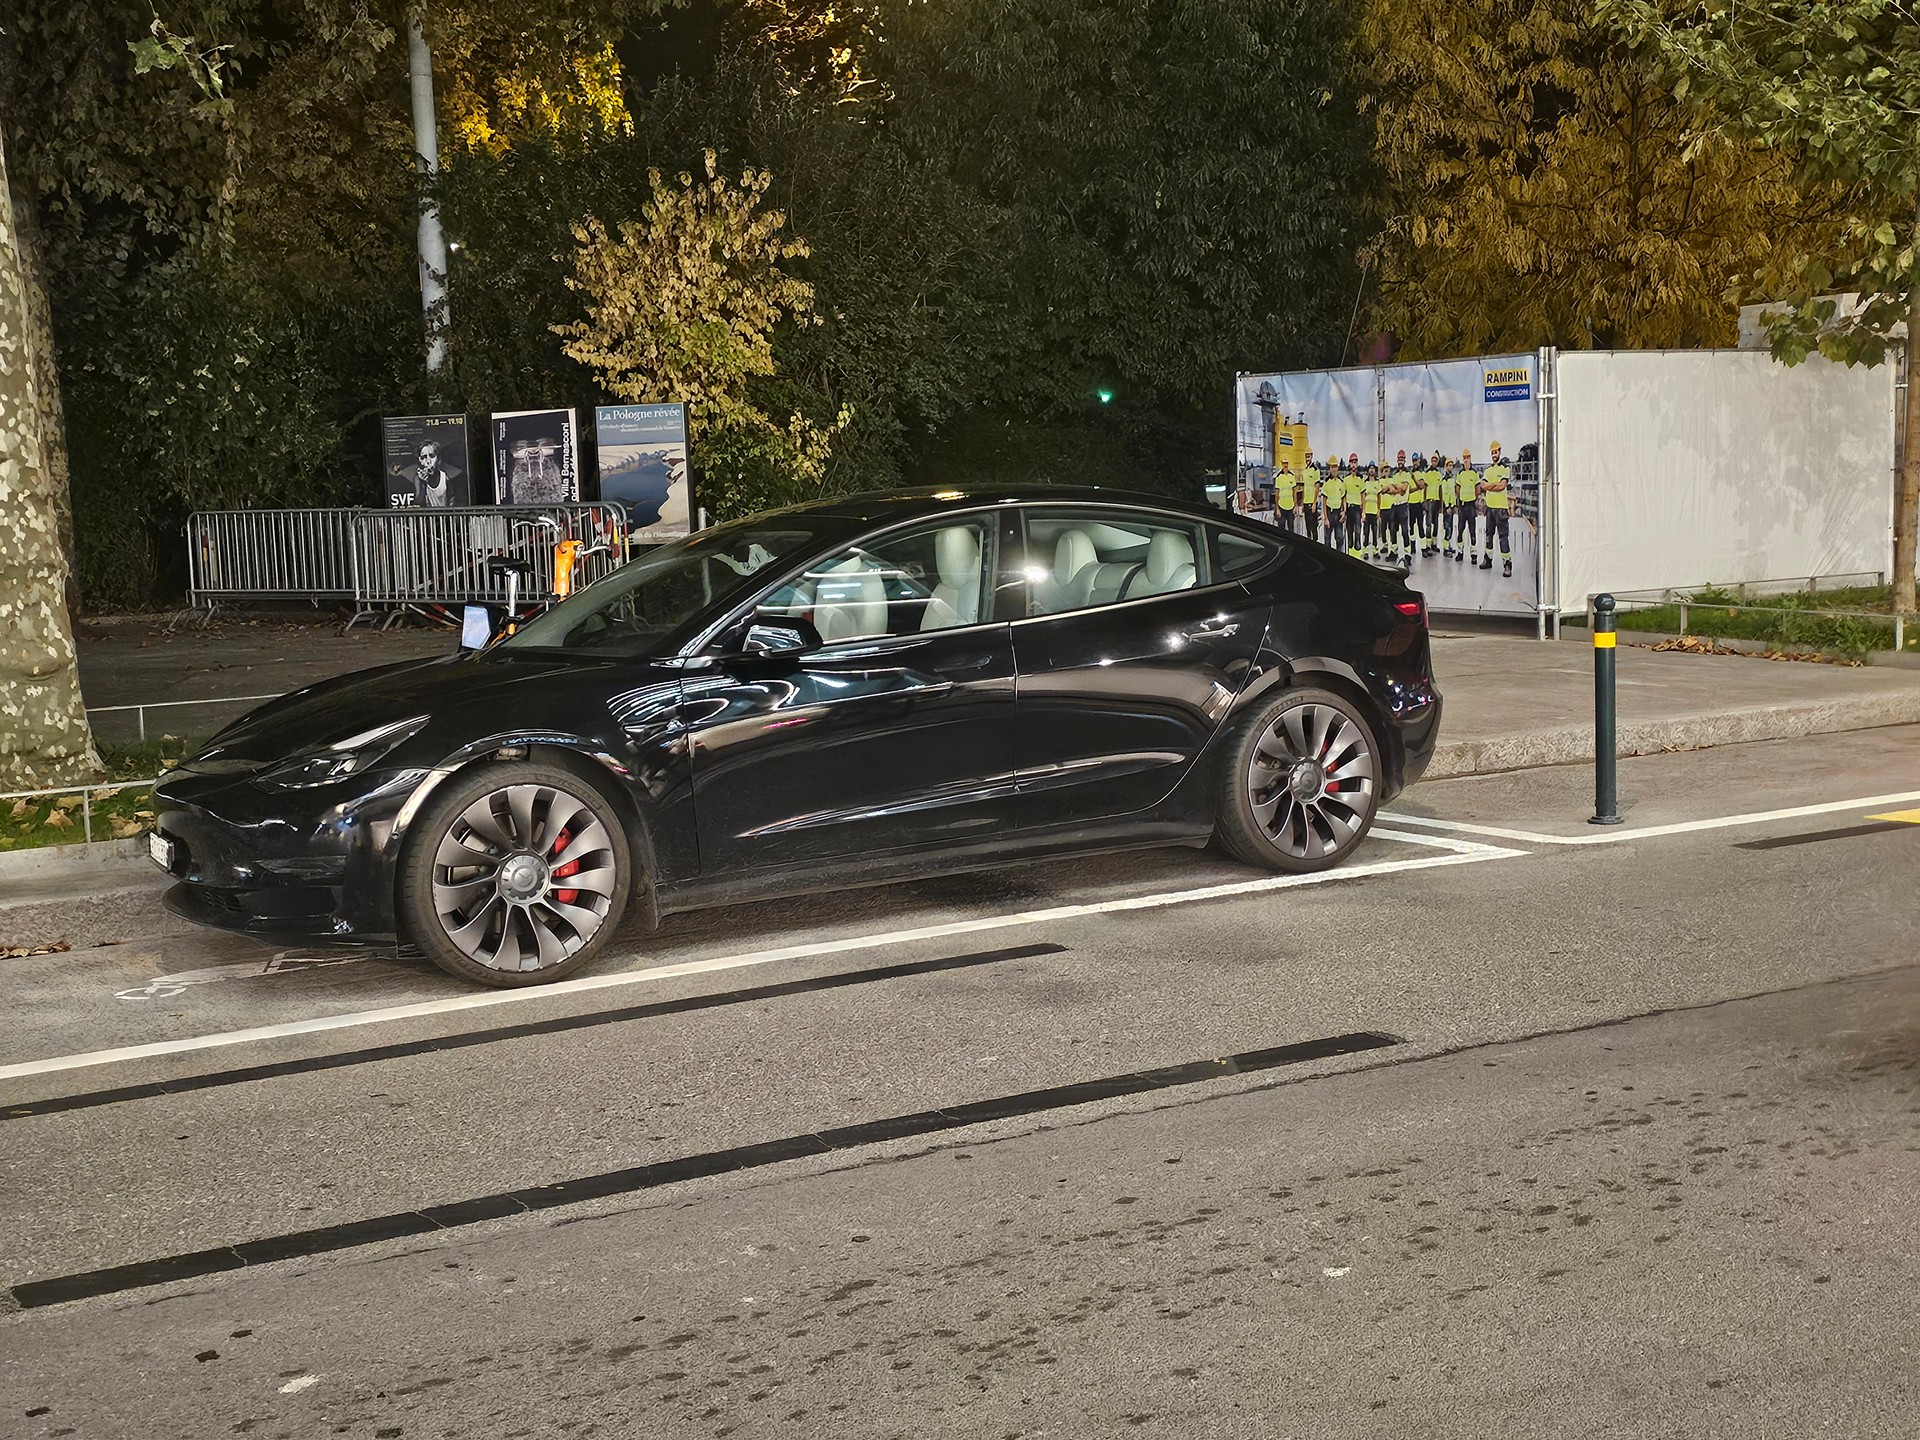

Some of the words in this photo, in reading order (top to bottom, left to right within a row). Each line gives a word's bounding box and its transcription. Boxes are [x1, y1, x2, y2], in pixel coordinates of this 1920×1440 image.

[1486, 371, 1527, 383] RAMPINI
[599, 411, 611, 420] La
[613, 409, 653, 421] Pologne
[561, 478, 569, 497] Villa
[391, 493, 414, 505] SVF
